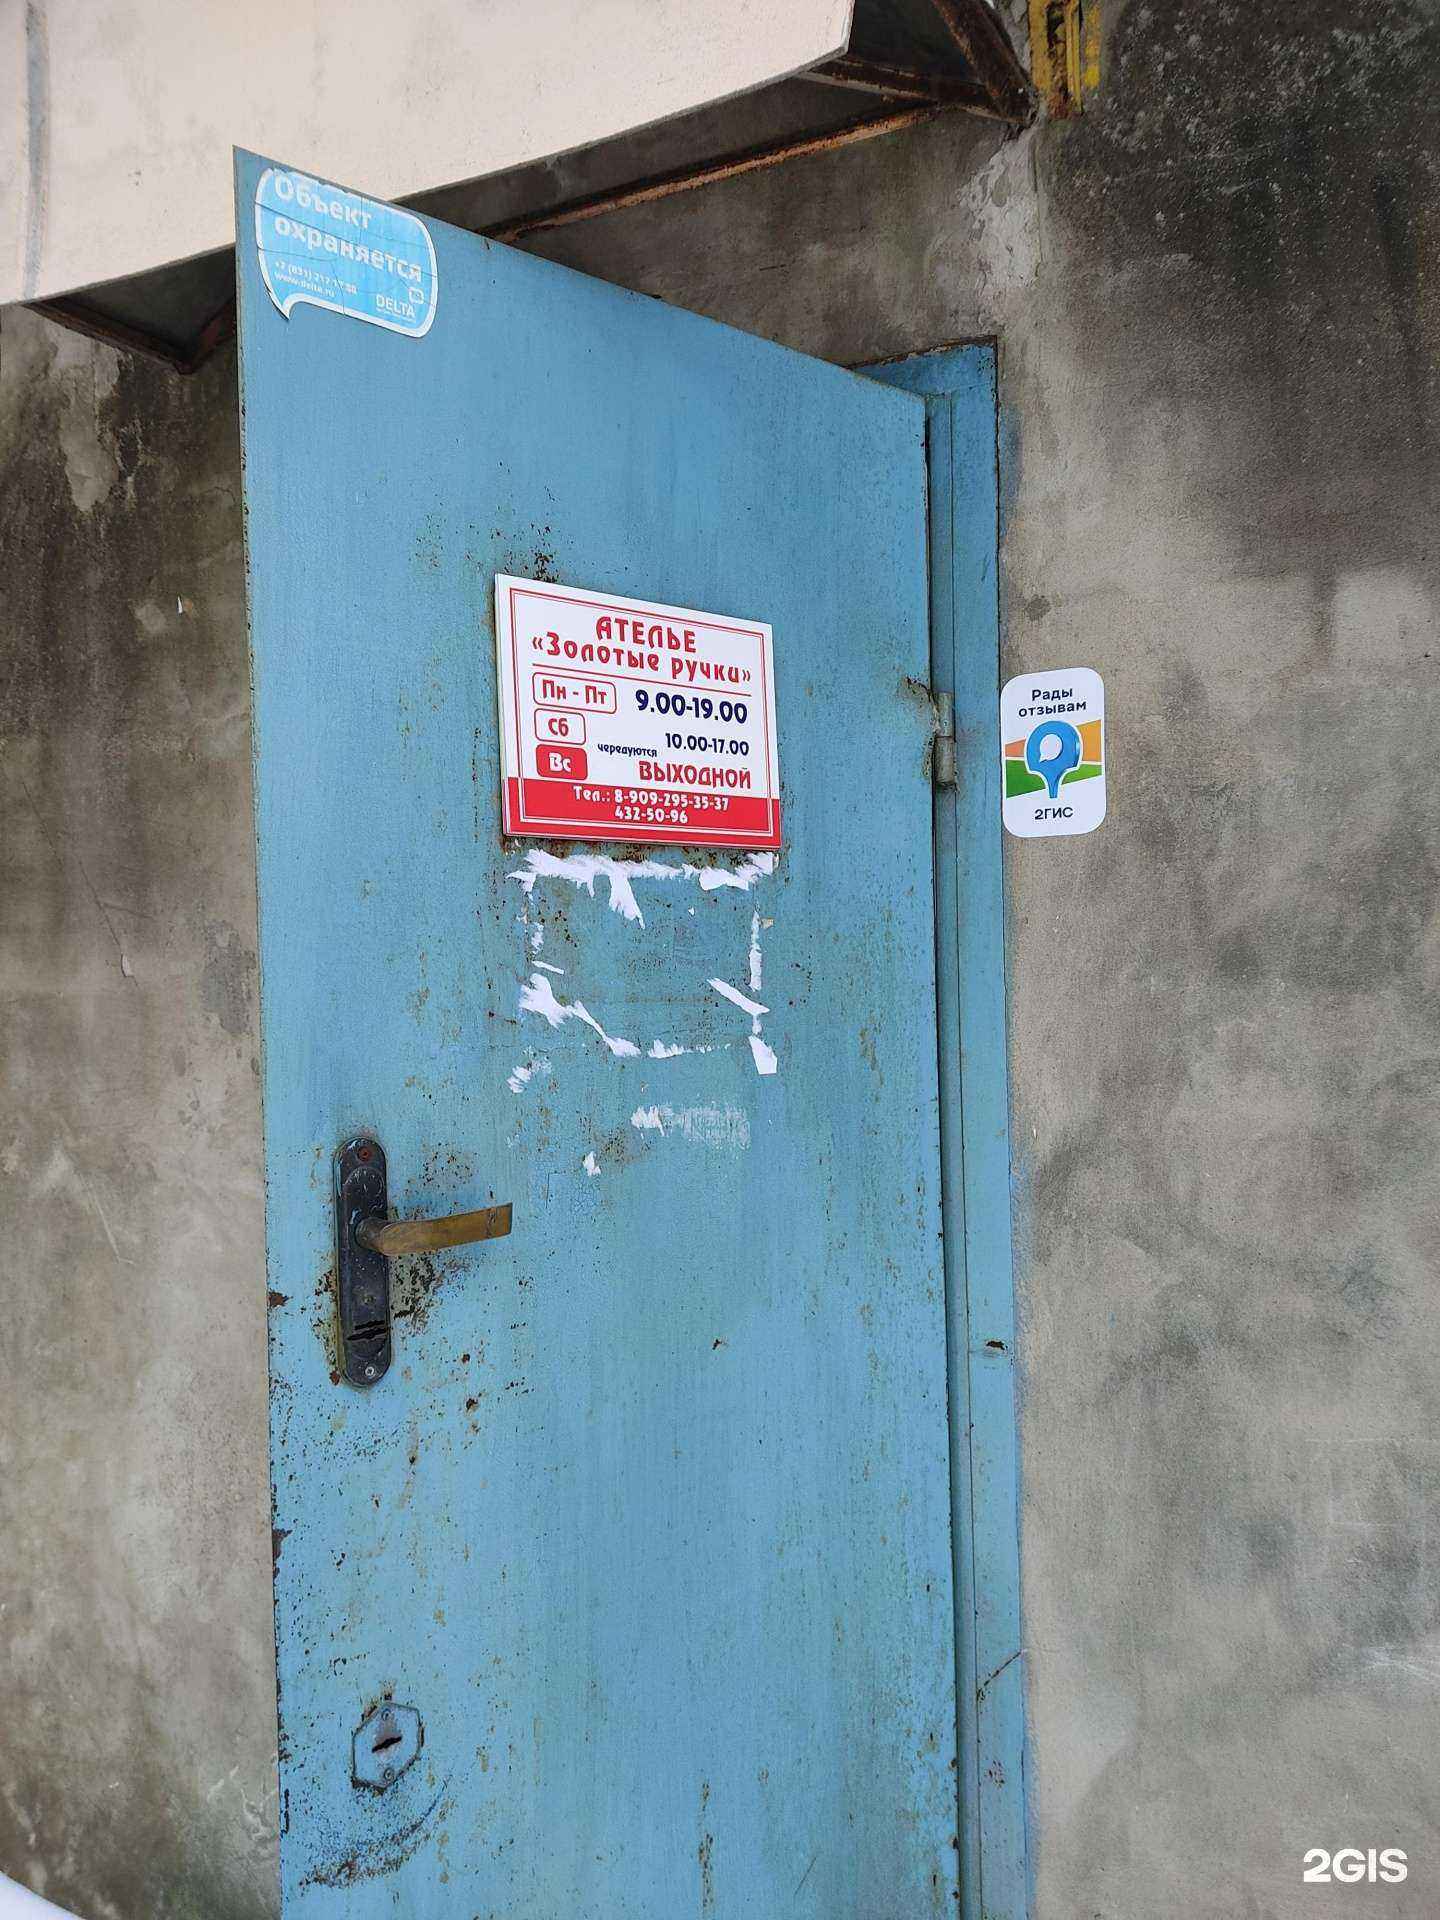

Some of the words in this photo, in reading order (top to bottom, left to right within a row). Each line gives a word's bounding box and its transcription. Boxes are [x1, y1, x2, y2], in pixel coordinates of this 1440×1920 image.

[274, 173, 372, 229] Объект
[274, 217, 422, 282] охраняется
[376, 294, 415, 317] DELTA
[596, 616, 696, 652] АТЕЛЬЕ
[532, 632, 660, 671] «Золотые
[671, 656, 751, 684] ручки»
[542, 680, 566, 700] Пн
[585, 684, 606, 704] Пт
[636, 689, 748, 724] 9.00-19.00
[1018, 701, 1087, 717] отзывам
[1032, 688, 1073, 701] Рады
[548, 718, 569, 736] Сб
[666, 733, 749, 756] 10.00-17.00
[598, 743, 658, 758] чередуются
[548, 753, 571, 772] Вс
[639, 761, 751, 789] ВЫХОДНОЙ
[574, 786, 610, 802] Тел.:
[614, 790, 728, 811] 8-909-295-35-37
[1034, 807, 1073, 820] 2ГИС
[614, 806, 688, 824] 432-50-96
